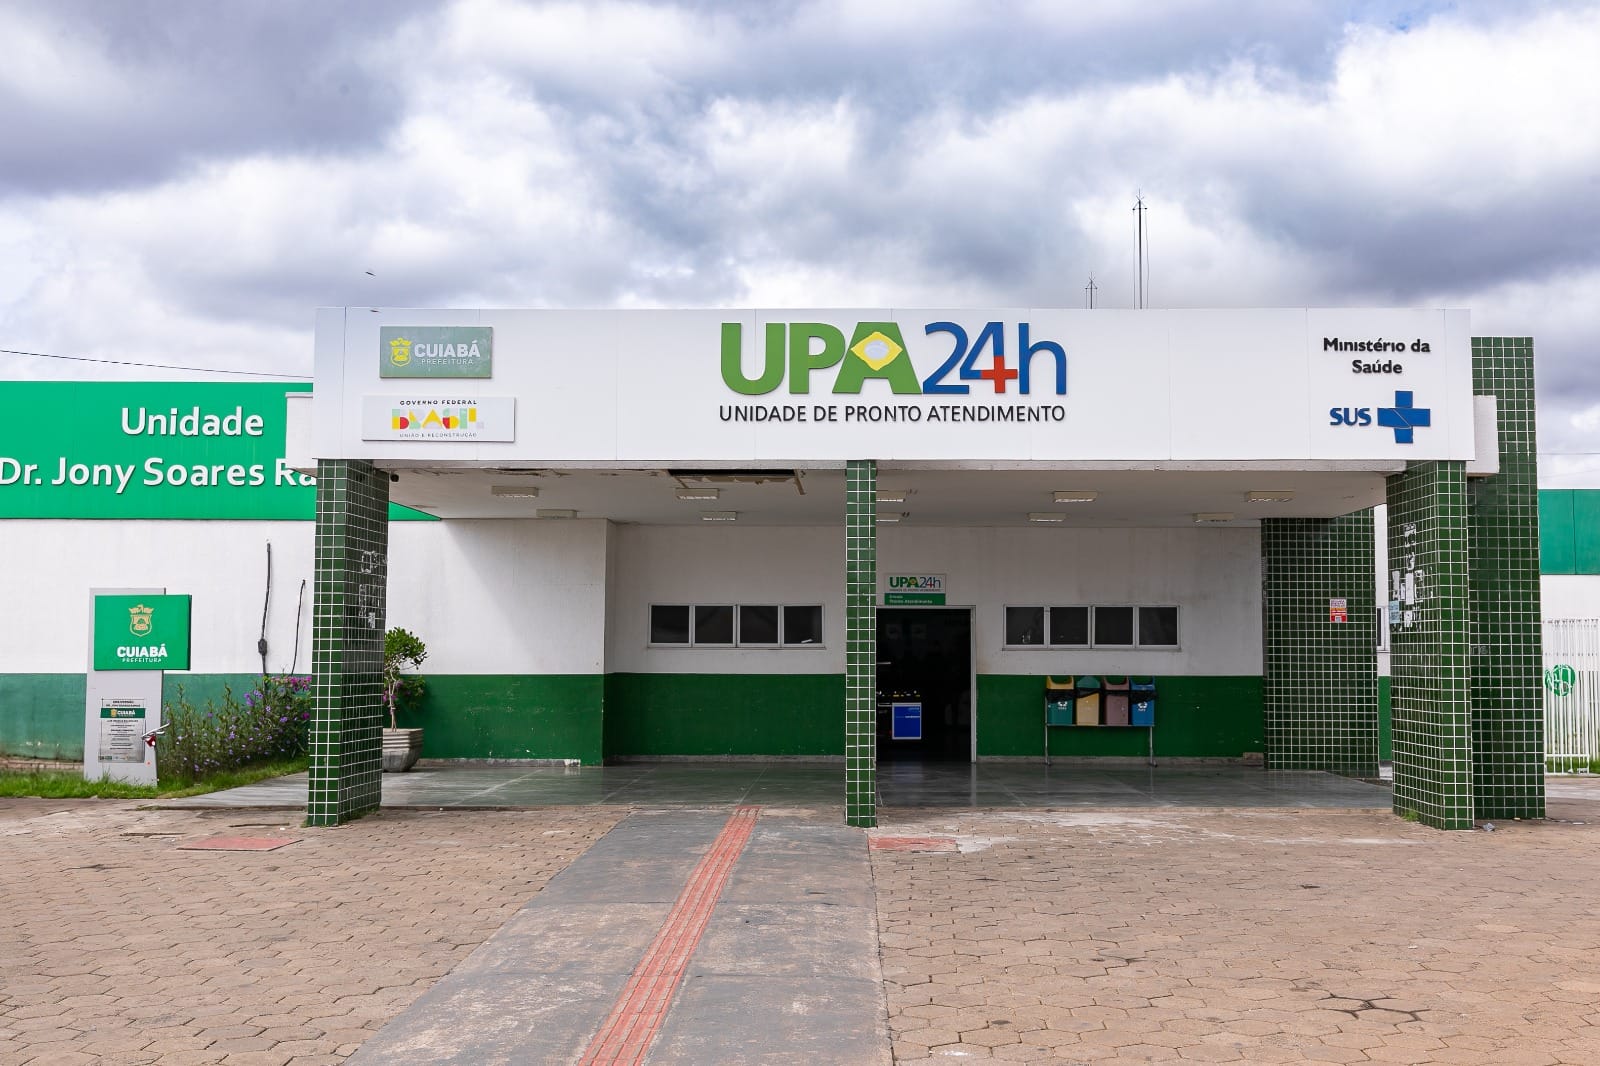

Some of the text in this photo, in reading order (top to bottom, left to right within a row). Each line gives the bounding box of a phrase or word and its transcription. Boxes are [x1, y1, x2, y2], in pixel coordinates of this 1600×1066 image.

[414, 339, 481, 358] CUIABÁ
[1323, 337, 1431, 352] Ministério da
[1351, 359, 1403, 374] Saúde
[121, 406, 264, 436] Unidade
[719, 405, 1066, 422] UNIDADE DE PRONTO ATENDIMENTO
[1329, 407, 1372, 426] SUS
[0, 457, 42, 485] Dr.
[51, 456, 136, 494] Jony
[143, 456, 265, 486] Soares
[116, 643, 168, 657] CUIABÁ
